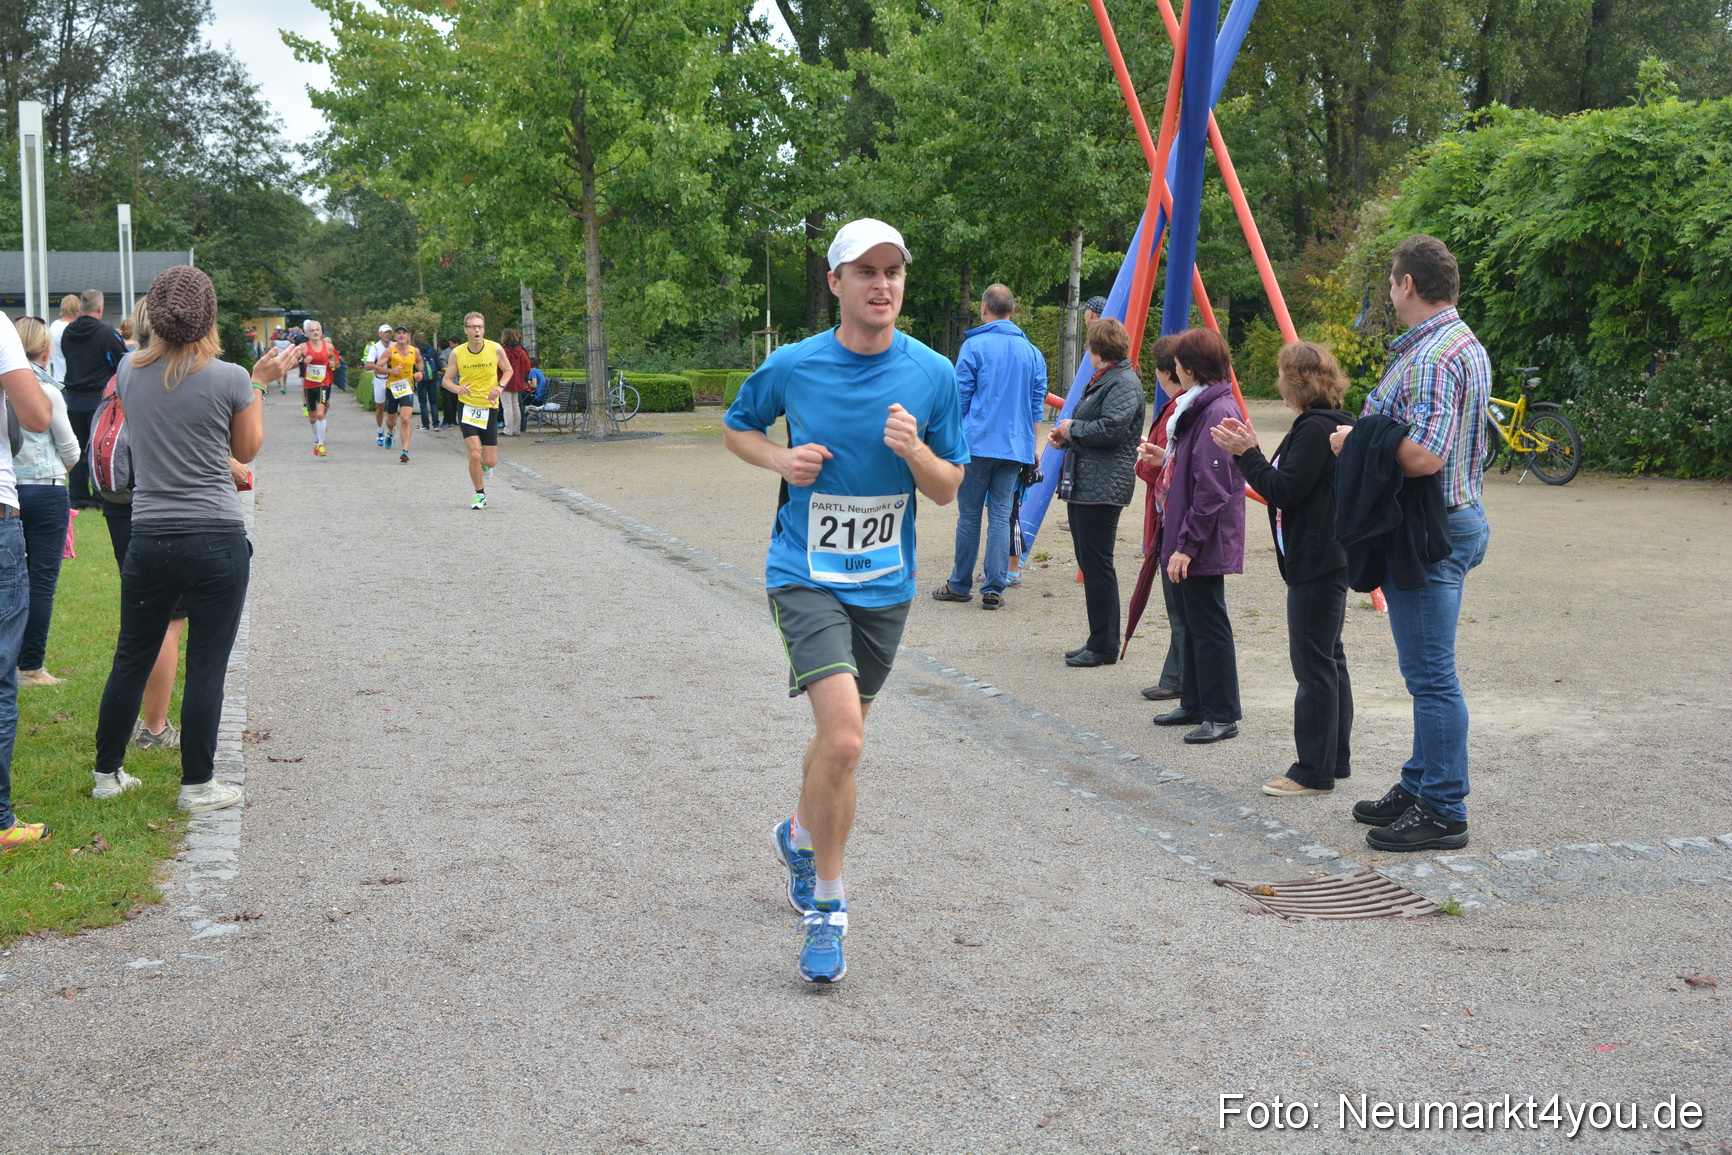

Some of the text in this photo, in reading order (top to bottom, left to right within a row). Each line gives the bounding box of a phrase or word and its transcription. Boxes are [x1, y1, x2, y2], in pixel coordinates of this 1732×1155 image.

[471, 409, 482, 419] 79
[812, 502, 891, 513] PARTL Neumarkt
[819, 513, 895, 549] 2120
[845, 558, 872, 571] Uwe
